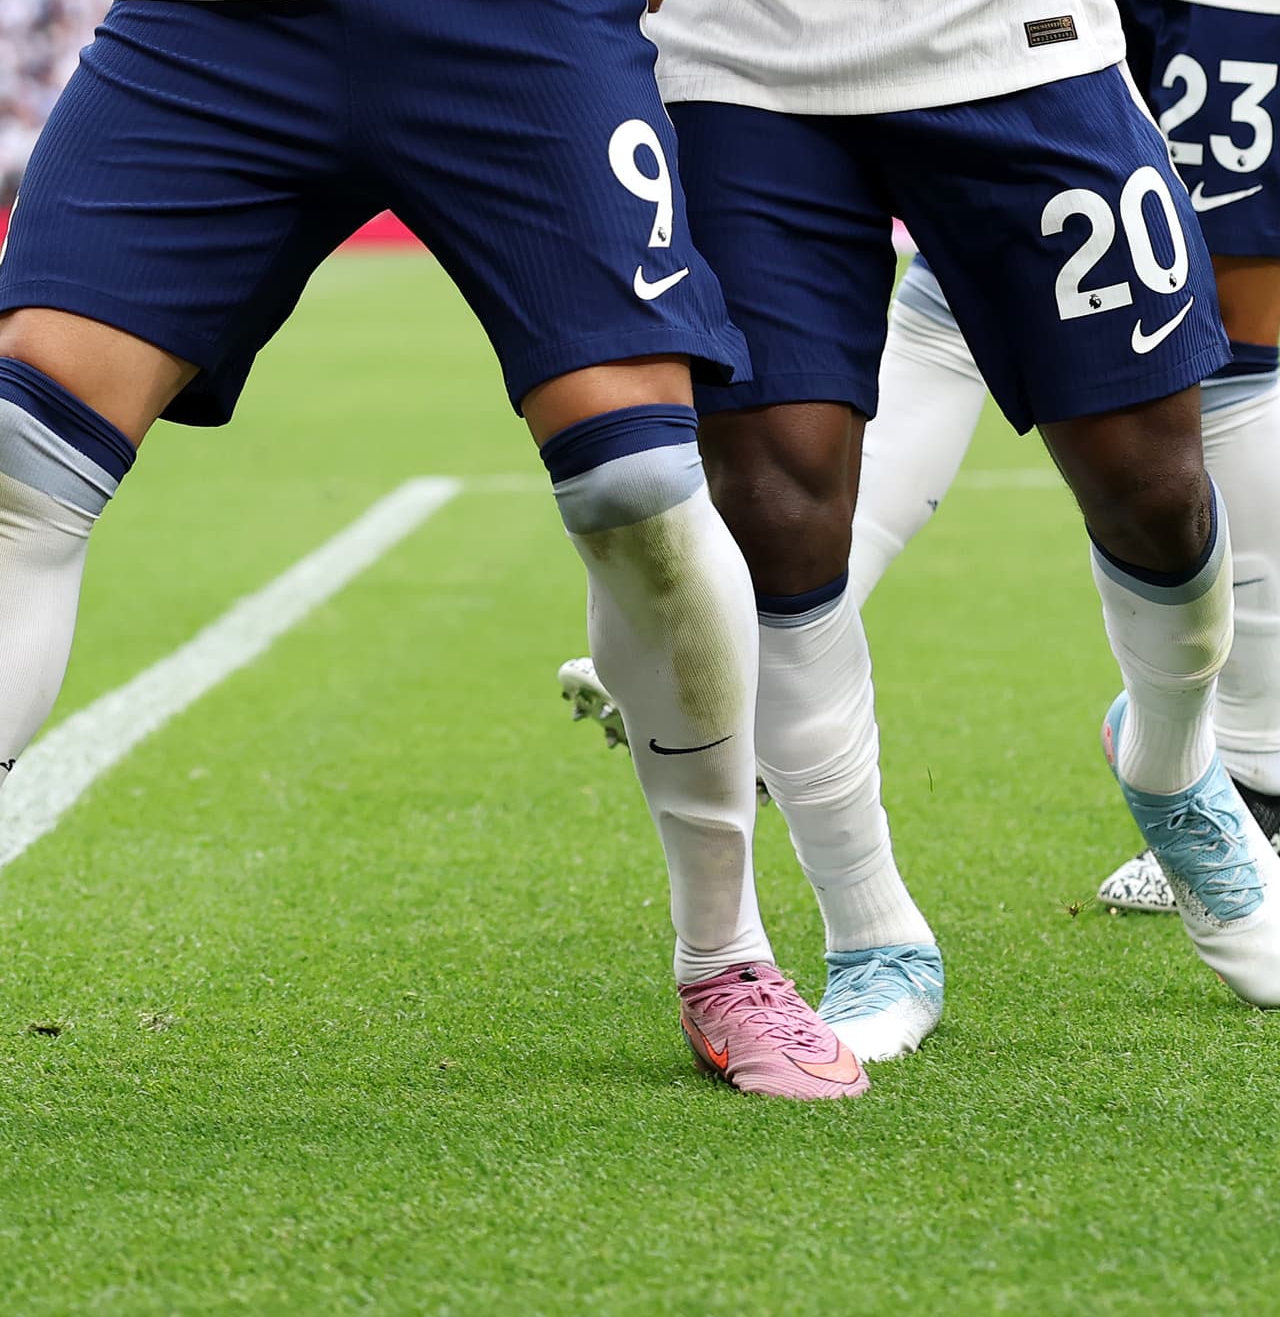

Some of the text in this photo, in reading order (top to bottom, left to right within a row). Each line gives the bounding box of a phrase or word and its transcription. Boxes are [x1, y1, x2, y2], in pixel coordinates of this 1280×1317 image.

[1160, 53, 1279, 173] 23
[608, 119, 675, 248] 9
[1040, 165, 1190, 321] 20
